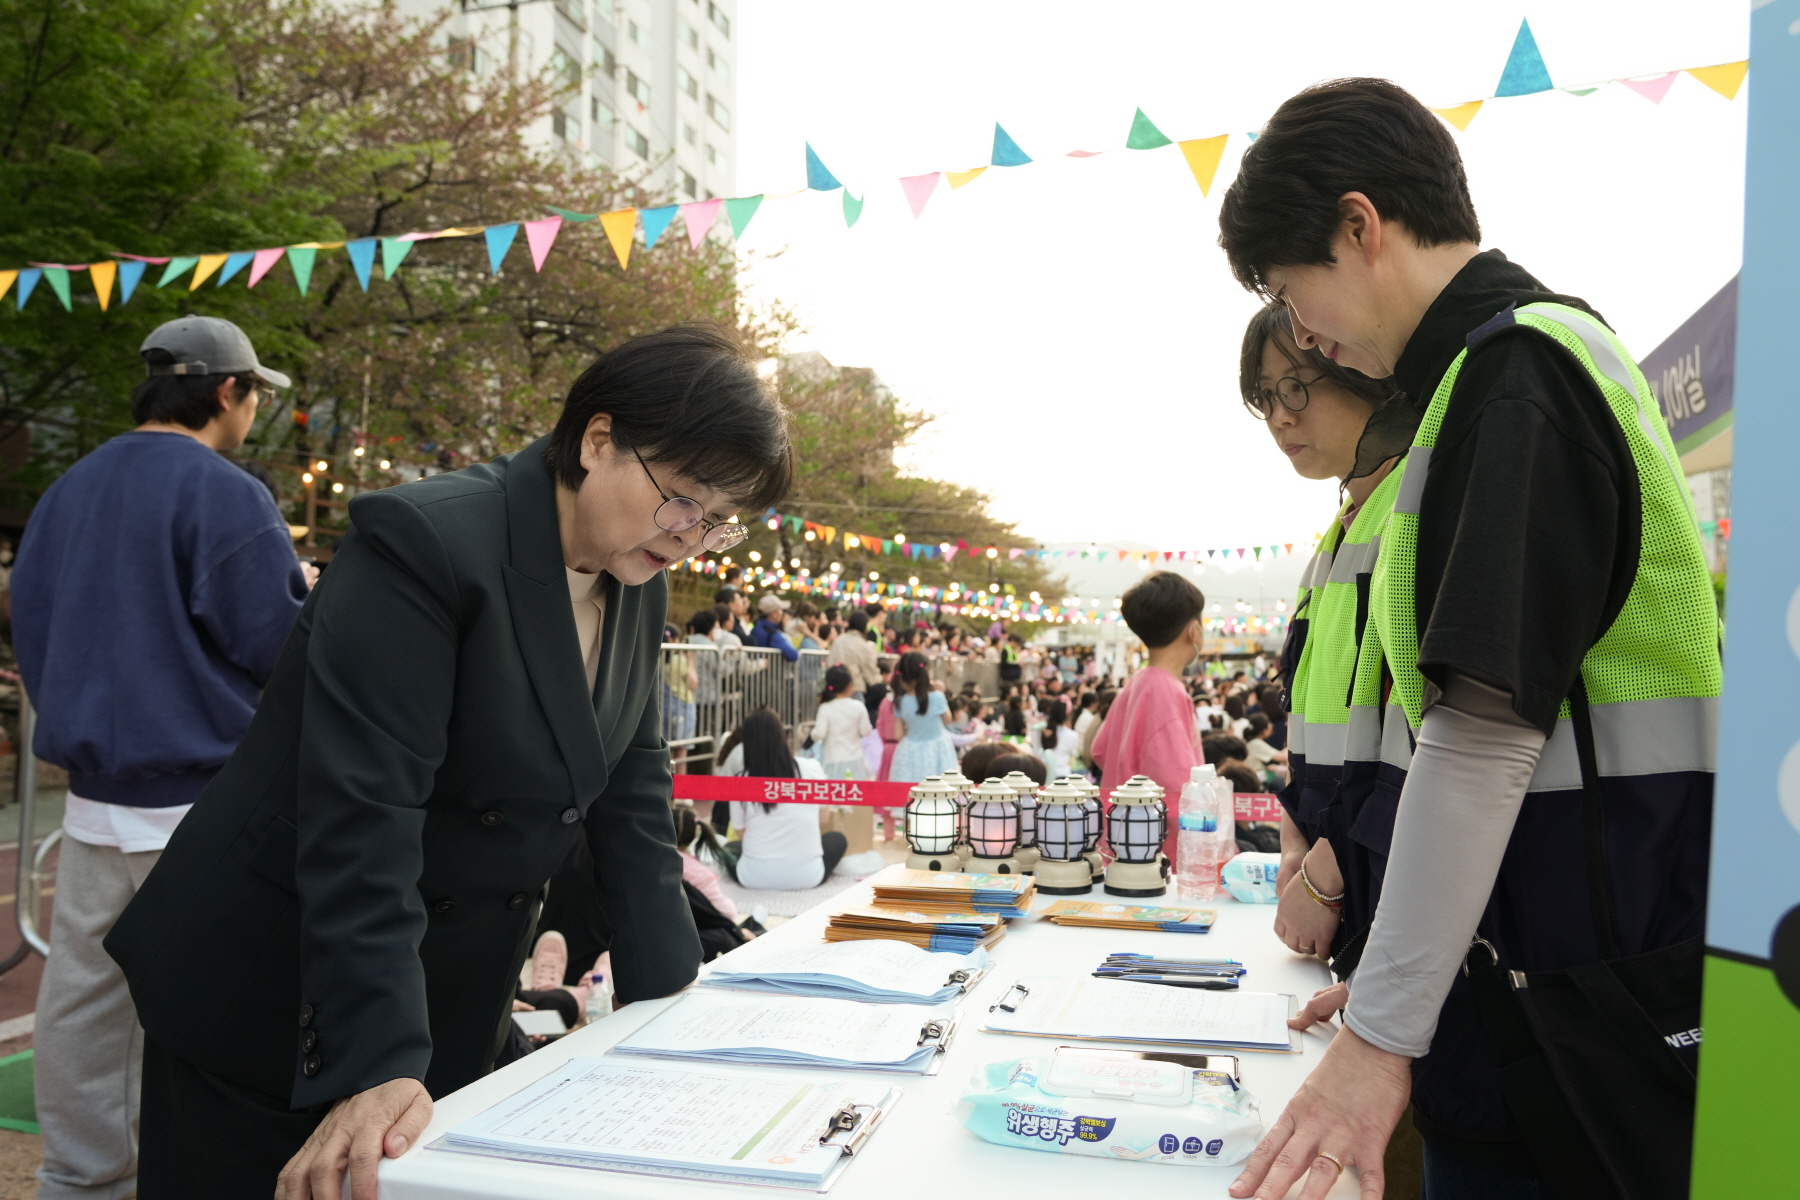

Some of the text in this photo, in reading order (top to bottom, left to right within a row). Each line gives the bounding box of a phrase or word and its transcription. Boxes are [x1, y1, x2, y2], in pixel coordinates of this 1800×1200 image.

[763, 780, 864, 802] 강북구보건소
[1007, 1108, 1076, 1146] 위생행주
[1079, 1117, 1107, 1128] 강력엠보싱
[1079, 1128, 1098, 1140] 99.9%
